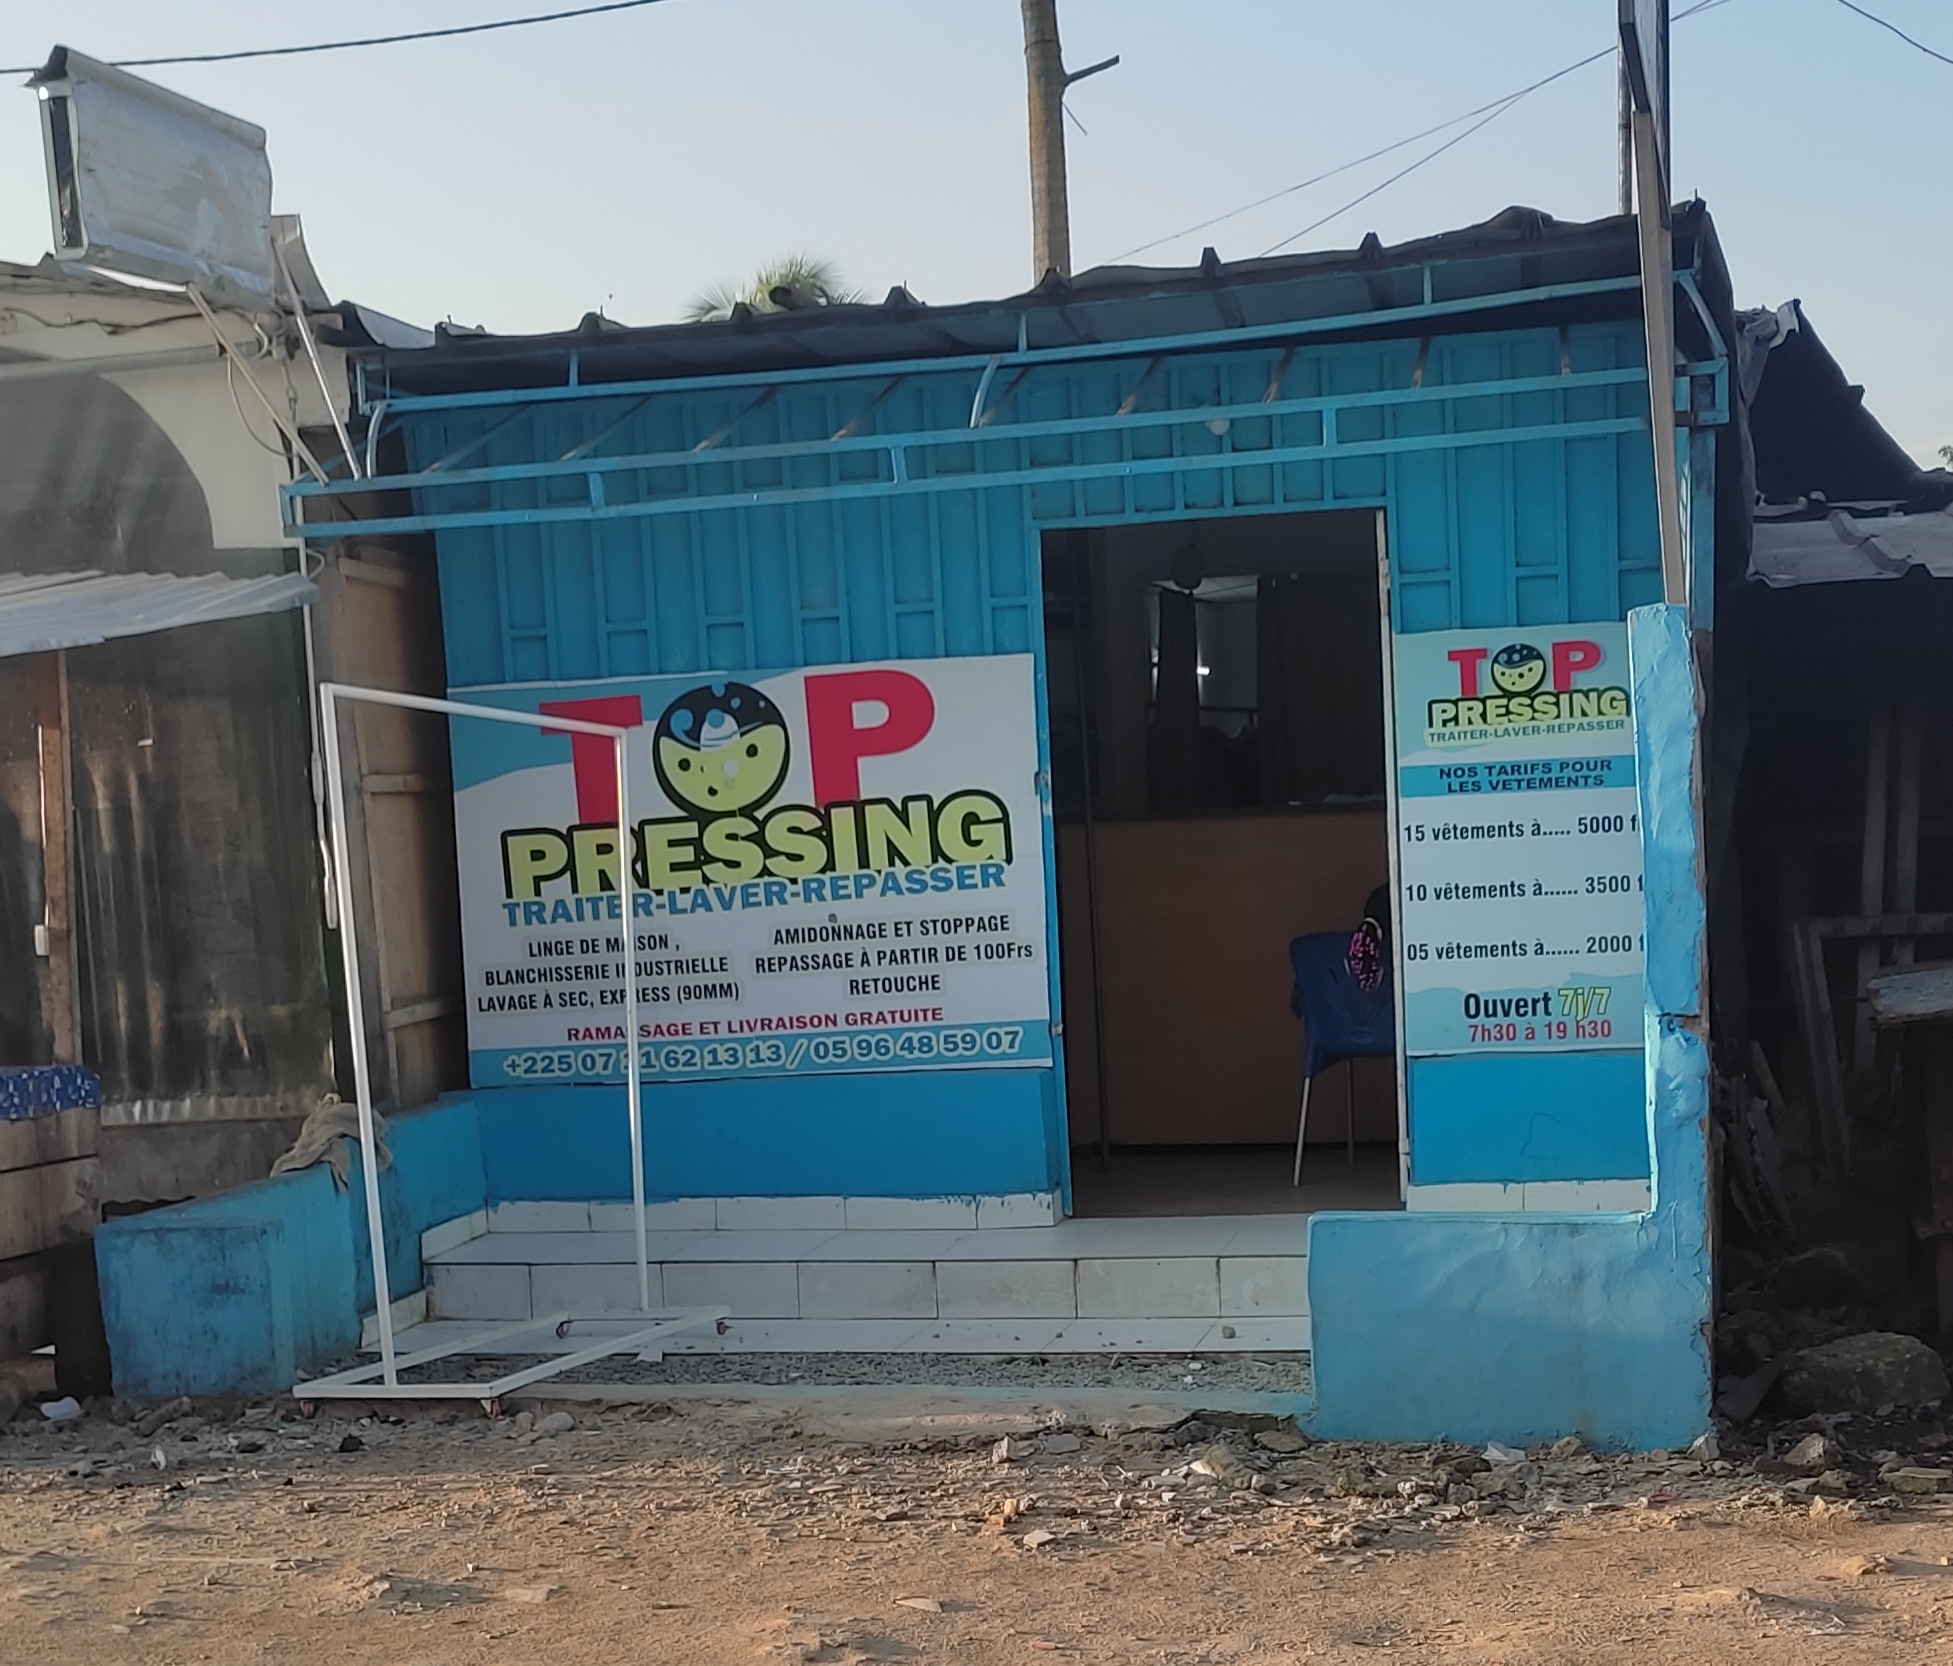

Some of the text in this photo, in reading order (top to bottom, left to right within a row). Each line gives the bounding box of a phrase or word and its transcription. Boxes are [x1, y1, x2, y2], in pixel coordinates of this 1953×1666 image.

[1447, 640, 1602, 698] TOP
[1428, 686, 1632, 729] PRESSING
[1429, 719, 1625, 743] TRAITER-LAVER-REPASSER
[1439, 759, 1613, 780] NOS TARIFS POUR
[1447, 775, 1605, 793] LES VETEMENTS
[1404, 825, 1425, 842] 15
[1431, 820, 1525, 841] vêtements
[1577, 816, 1624, 835] 5000
[502, 790, 1012, 900] PRESSING
[1405, 884, 1427, 902] 10
[1433, 880, 1526, 901] vêtements
[1584, 875, 1631, 895] 3500
[773, 915, 1010, 946] AMIDONNAGE ET STOPPAGE
[528, 939, 574, 958] LINGE
[580, 938, 600, 954] DE
[755, 942, 1033, 974] REPASSAGE À PARTIR DE 100Frs
[1407, 943, 1429, 961] 05
[1435, 940, 1528, 960] vêtements
[1586, 935, 1632, 954] 2000
[485, 964, 610, 986] BLANCHISSERIE
[849, 974, 941, 995] RETOUCHE
[478, 993, 538, 1012] LAVAGE
[543, 989, 554, 1009] À
[558, 991, 595, 1009] SEC,
[677, 981, 740, 1005] (90MM)
[1463, 986, 1612, 1022] Ouvert 7j/7
[567, 1007, 944, 1042] RAMASAGE ET LIVRAISON GRATUITE
[1468, 1019, 1612, 1043] 7h30 à 19 h30
[506, 1054, 574, 1075] +225
[580, 1052, 614, 1072] 07
[663, 1048, 698, 1068] 62
[707, 1046, 740, 1066] 13
[748, 1043, 782, 1064] 13
[812, 1040, 849, 1060] 05
[855, 1037, 891, 1057] 96
[900, 1036, 935, 1056] 48
[942, 1033, 978, 1052] 59
[985, 1030, 1021, 1050] 07
